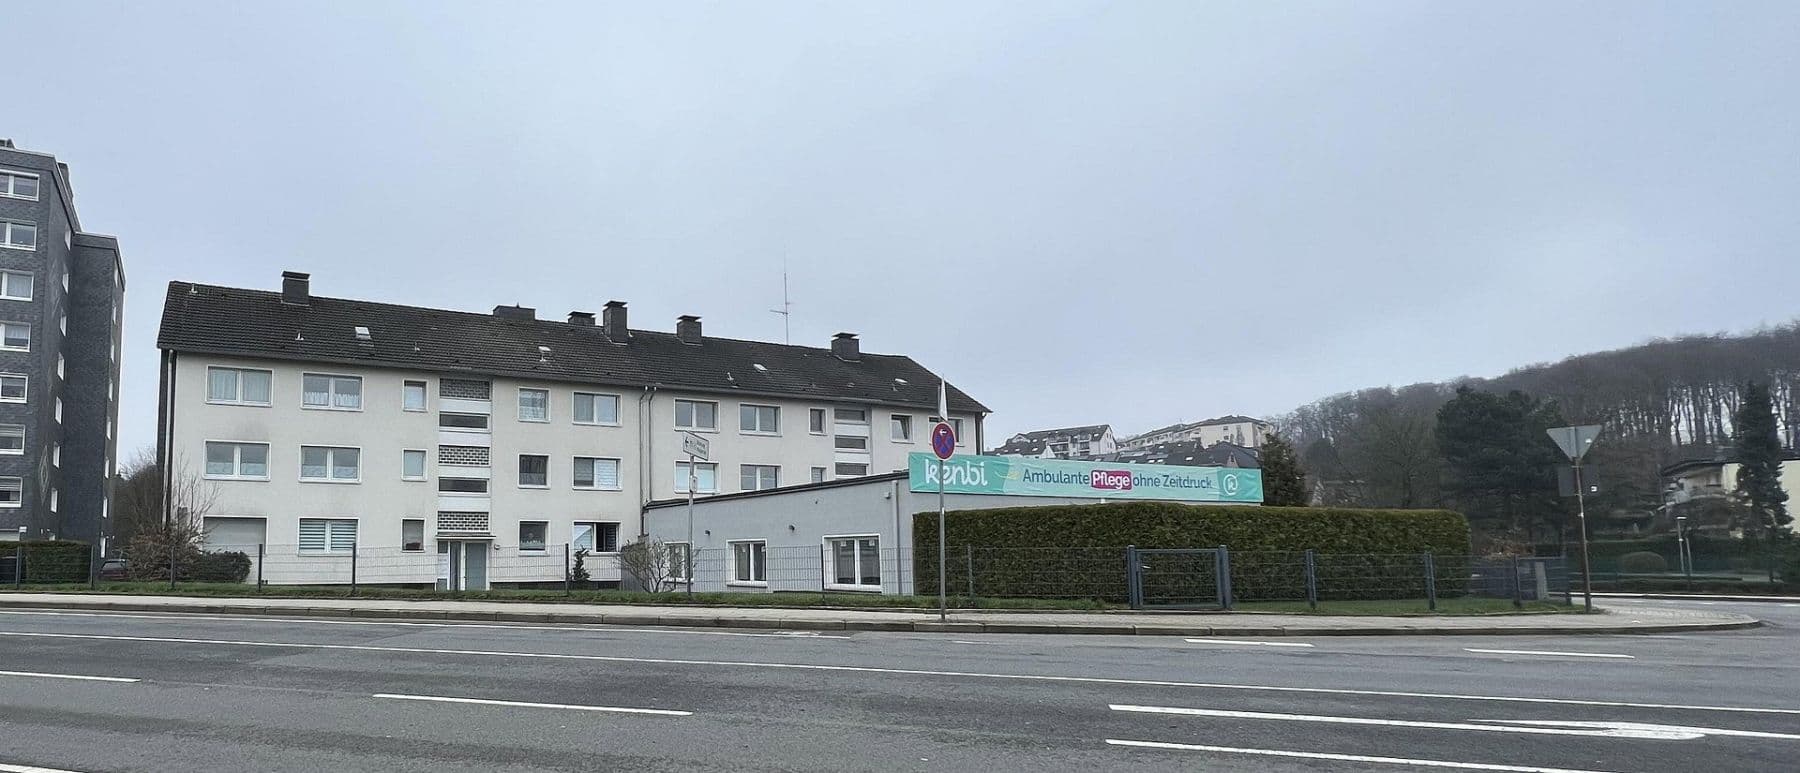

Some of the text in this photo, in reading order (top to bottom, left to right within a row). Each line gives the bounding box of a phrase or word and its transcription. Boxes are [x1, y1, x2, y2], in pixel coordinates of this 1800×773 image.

[925, 458, 988, 486] kenbi
[1022, 468, 1212, 490] Ambulante Pflege ohne Zeitdruck
